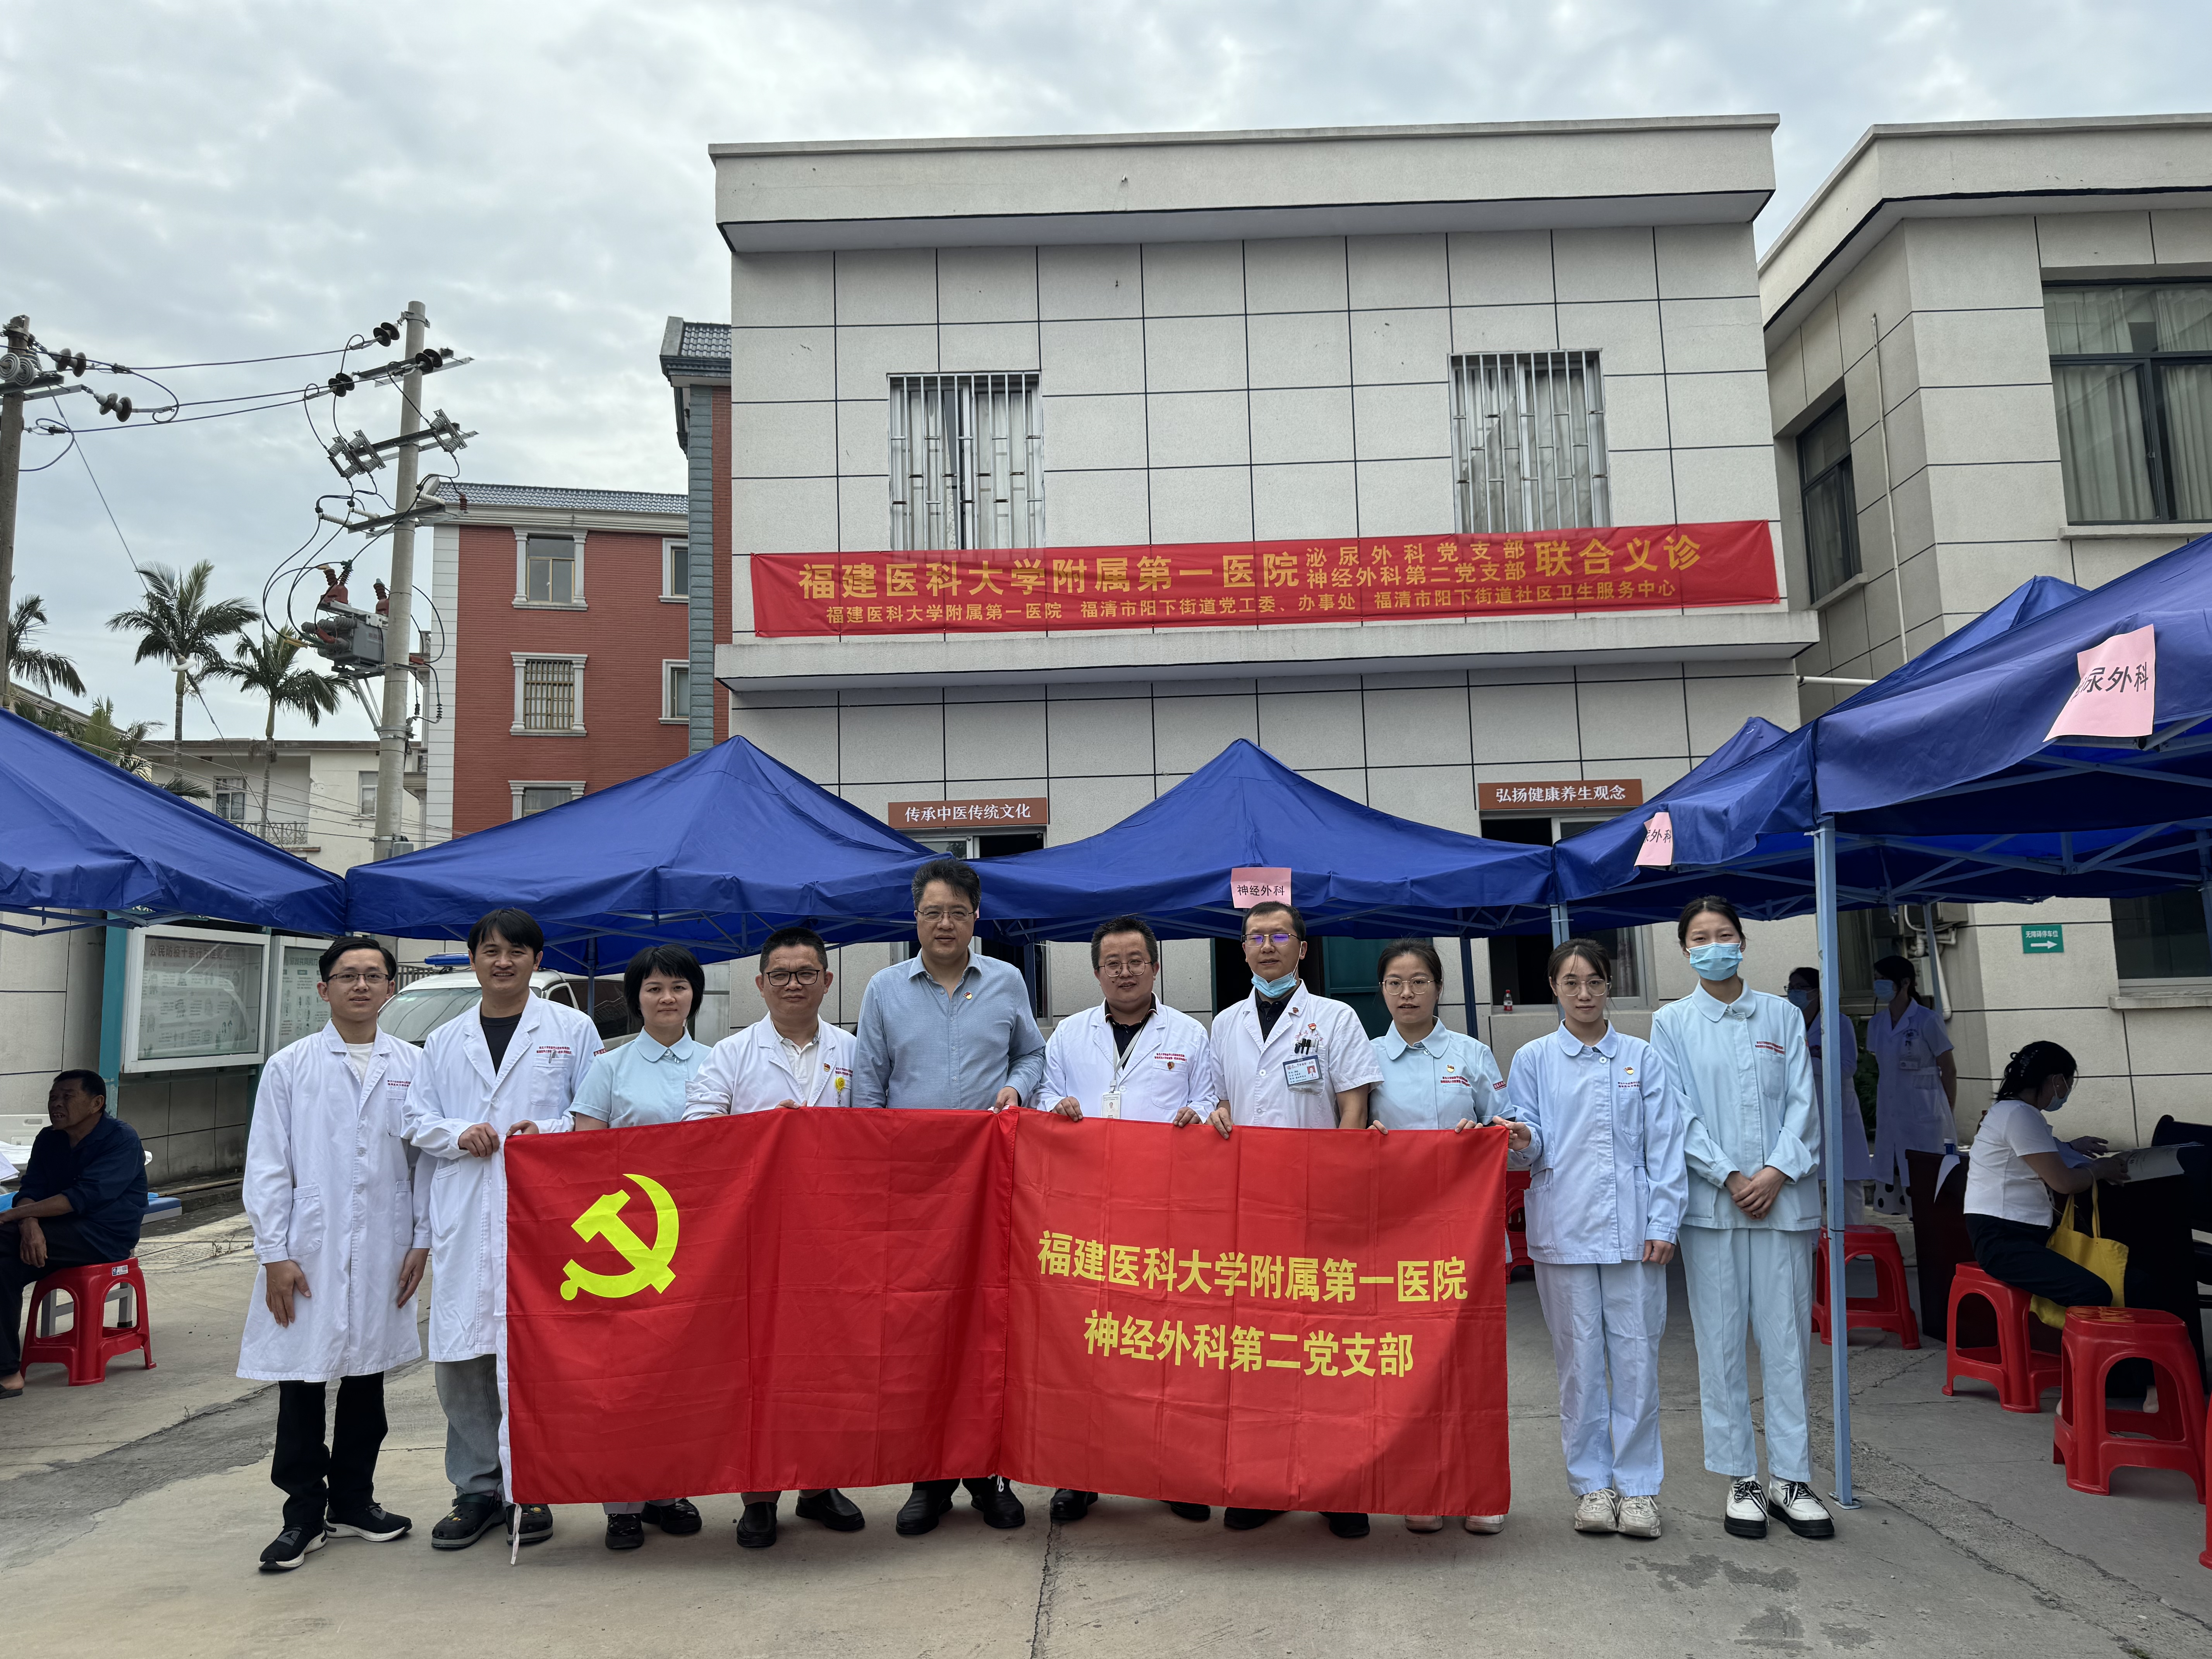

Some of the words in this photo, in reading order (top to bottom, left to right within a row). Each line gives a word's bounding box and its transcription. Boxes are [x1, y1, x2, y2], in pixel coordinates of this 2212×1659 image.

[1307, 539, 1525, 567] 泌尿外科党支部
[1534, 535, 1700, 577] 联合义诊
[799, 552, 1299, 599] 福建医科大学附属第一医院
[1307, 561, 1526, 589] 神经外科第二党支部
[827, 603, 1061, 623] 福建医科大学附属第一医院
[1375, 580, 1675, 608] 福清市阳下街道社区卫生服务中心
[1496, 785, 1626, 803] 弘扬健康养生观念
[905, 803, 1031, 822] 传承中医传统文化
[1237, 884, 1285, 896] 神经外科
[1038, 1230, 1468, 1303] 福建医科大学附属第一医院
[1084, 1309, 1413, 1377] 神经外科第二党支部
